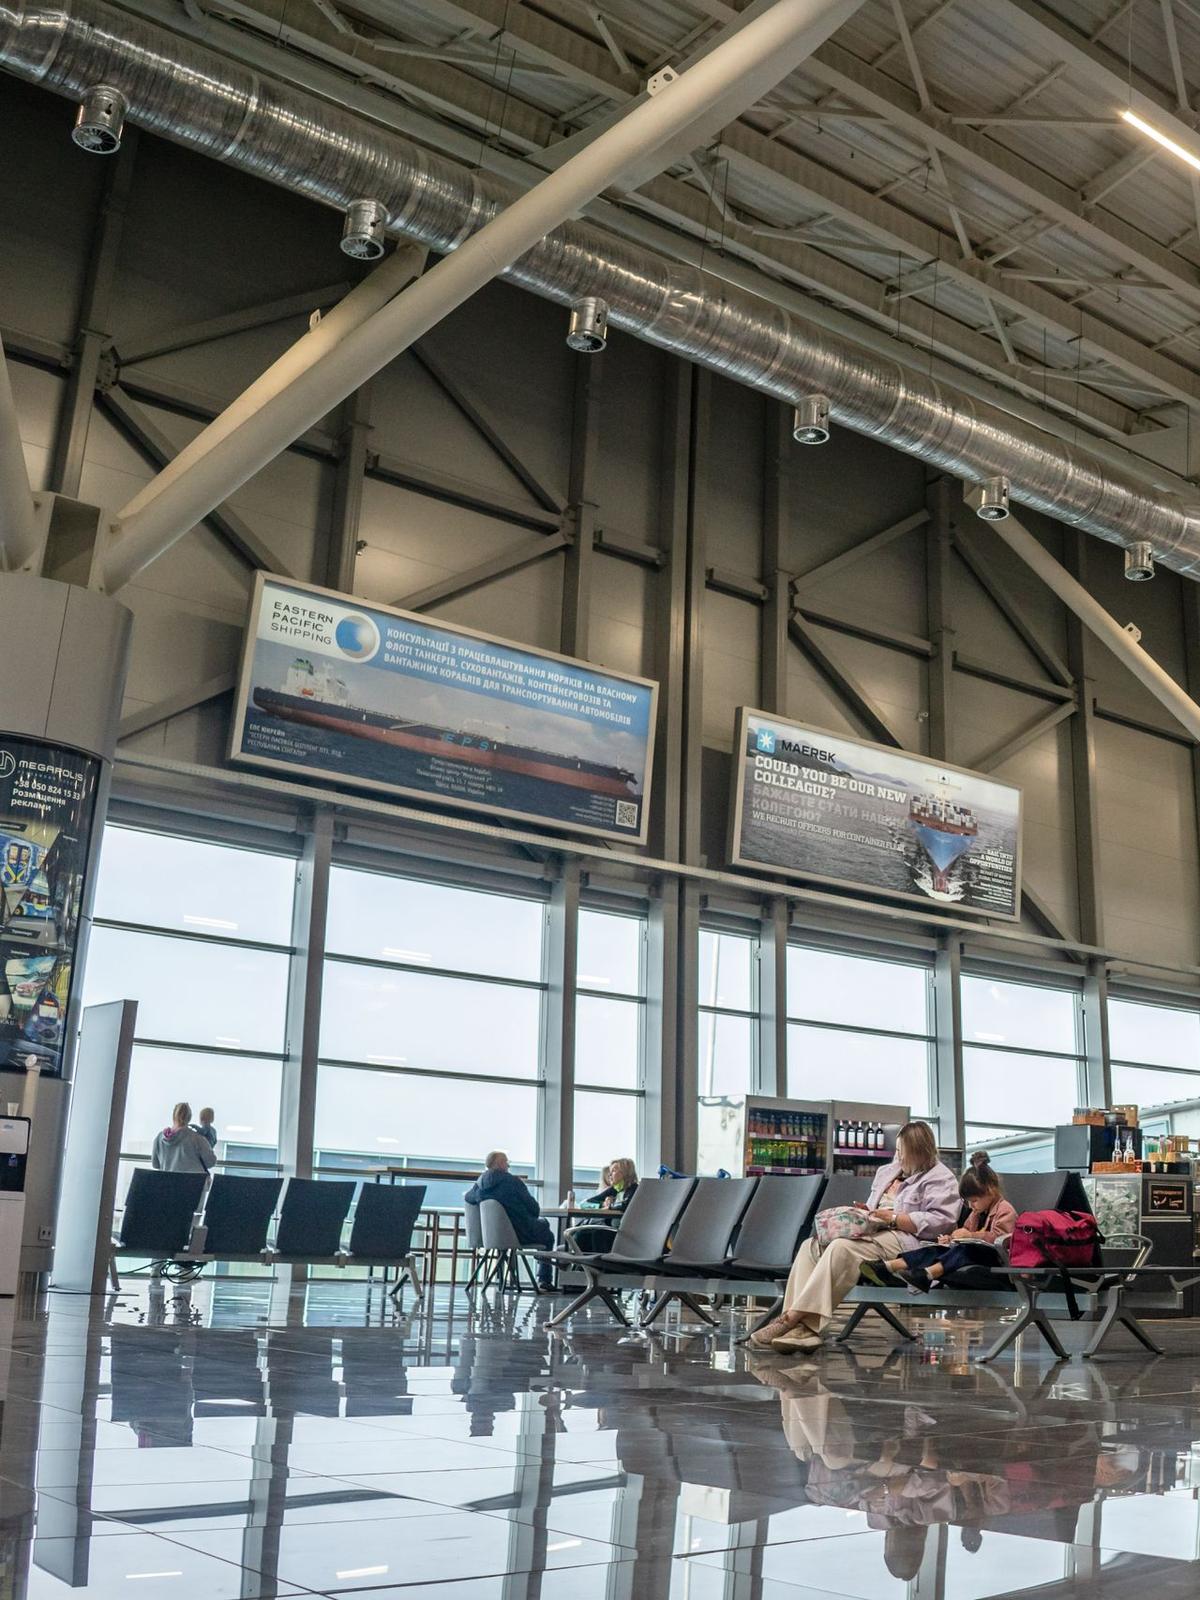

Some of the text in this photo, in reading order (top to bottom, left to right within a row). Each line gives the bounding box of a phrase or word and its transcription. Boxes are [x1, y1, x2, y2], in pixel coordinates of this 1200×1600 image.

[272, 612, 324, 632] PACIFIC
[274, 601, 333, 624] EASTERN
[271, 623, 332, 645] SHIPPING
[386, 641, 412, 655] ФЛОТІ
[528, 678, 601, 706] КОНТЕЙНЕРОВОЗІВ
[603, 698, 611, 709] ТА
[387, 628, 449, 652] КОНСУЛЬТАЦІЇ
[458, 648, 546, 678] ПРАЦЕВЛАШТУВАННЯ
[548, 672, 582, 689] МОРЯКІВ
[584, 682, 595, 692] НА
[597, 686, 637, 704] ВЛАСНОМУ
[384, 653, 631, 725] ВАНТАЖНИХ КОРАБЛІВ ДЛЯ ТРАНСПОРТУВАННЯ АВТОМОБІЛІВ
[781, 740, 836, 763] MAERSK
[19, 760, 83, 782] MEGAPOLIS
[755, 755, 906, 803] COULD YOU BE OUR NEW
[14, 780, 80, 800] +38 050 824 15 33
[754, 769, 836, 800] COLLEAGUE?
[11, 798, 51, 812] реклами
[753, 810, 765, 820] WE
[766, 813, 797, 827] RECRUIT
[798, 820, 831, 835] OFFICERS
[832, 829, 846, 839] FOR
